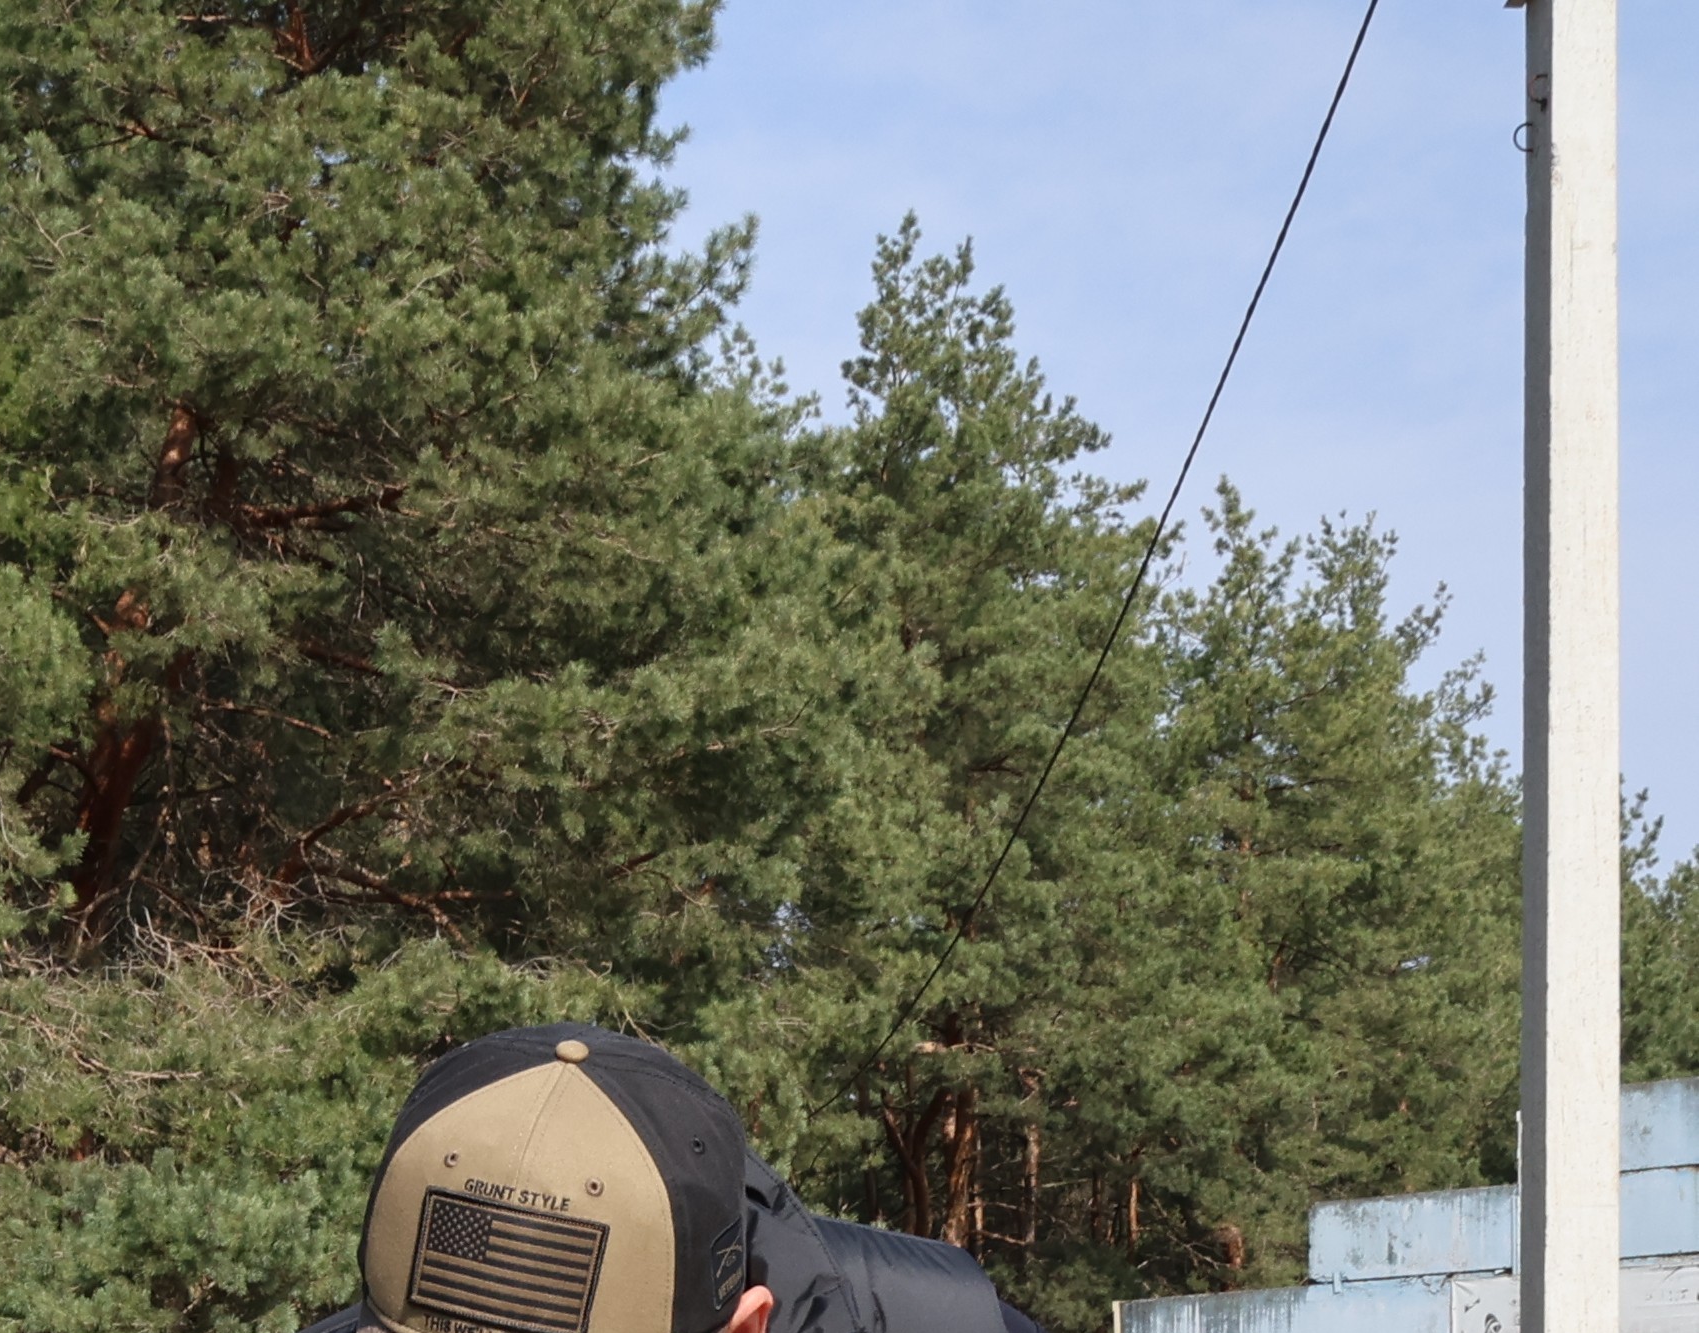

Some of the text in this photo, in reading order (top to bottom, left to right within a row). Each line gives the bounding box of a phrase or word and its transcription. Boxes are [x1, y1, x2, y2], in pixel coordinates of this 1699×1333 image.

[464, 1178, 571, 1212] GRUNT STYLE
[422, 1314, 451, 1333] THIS
